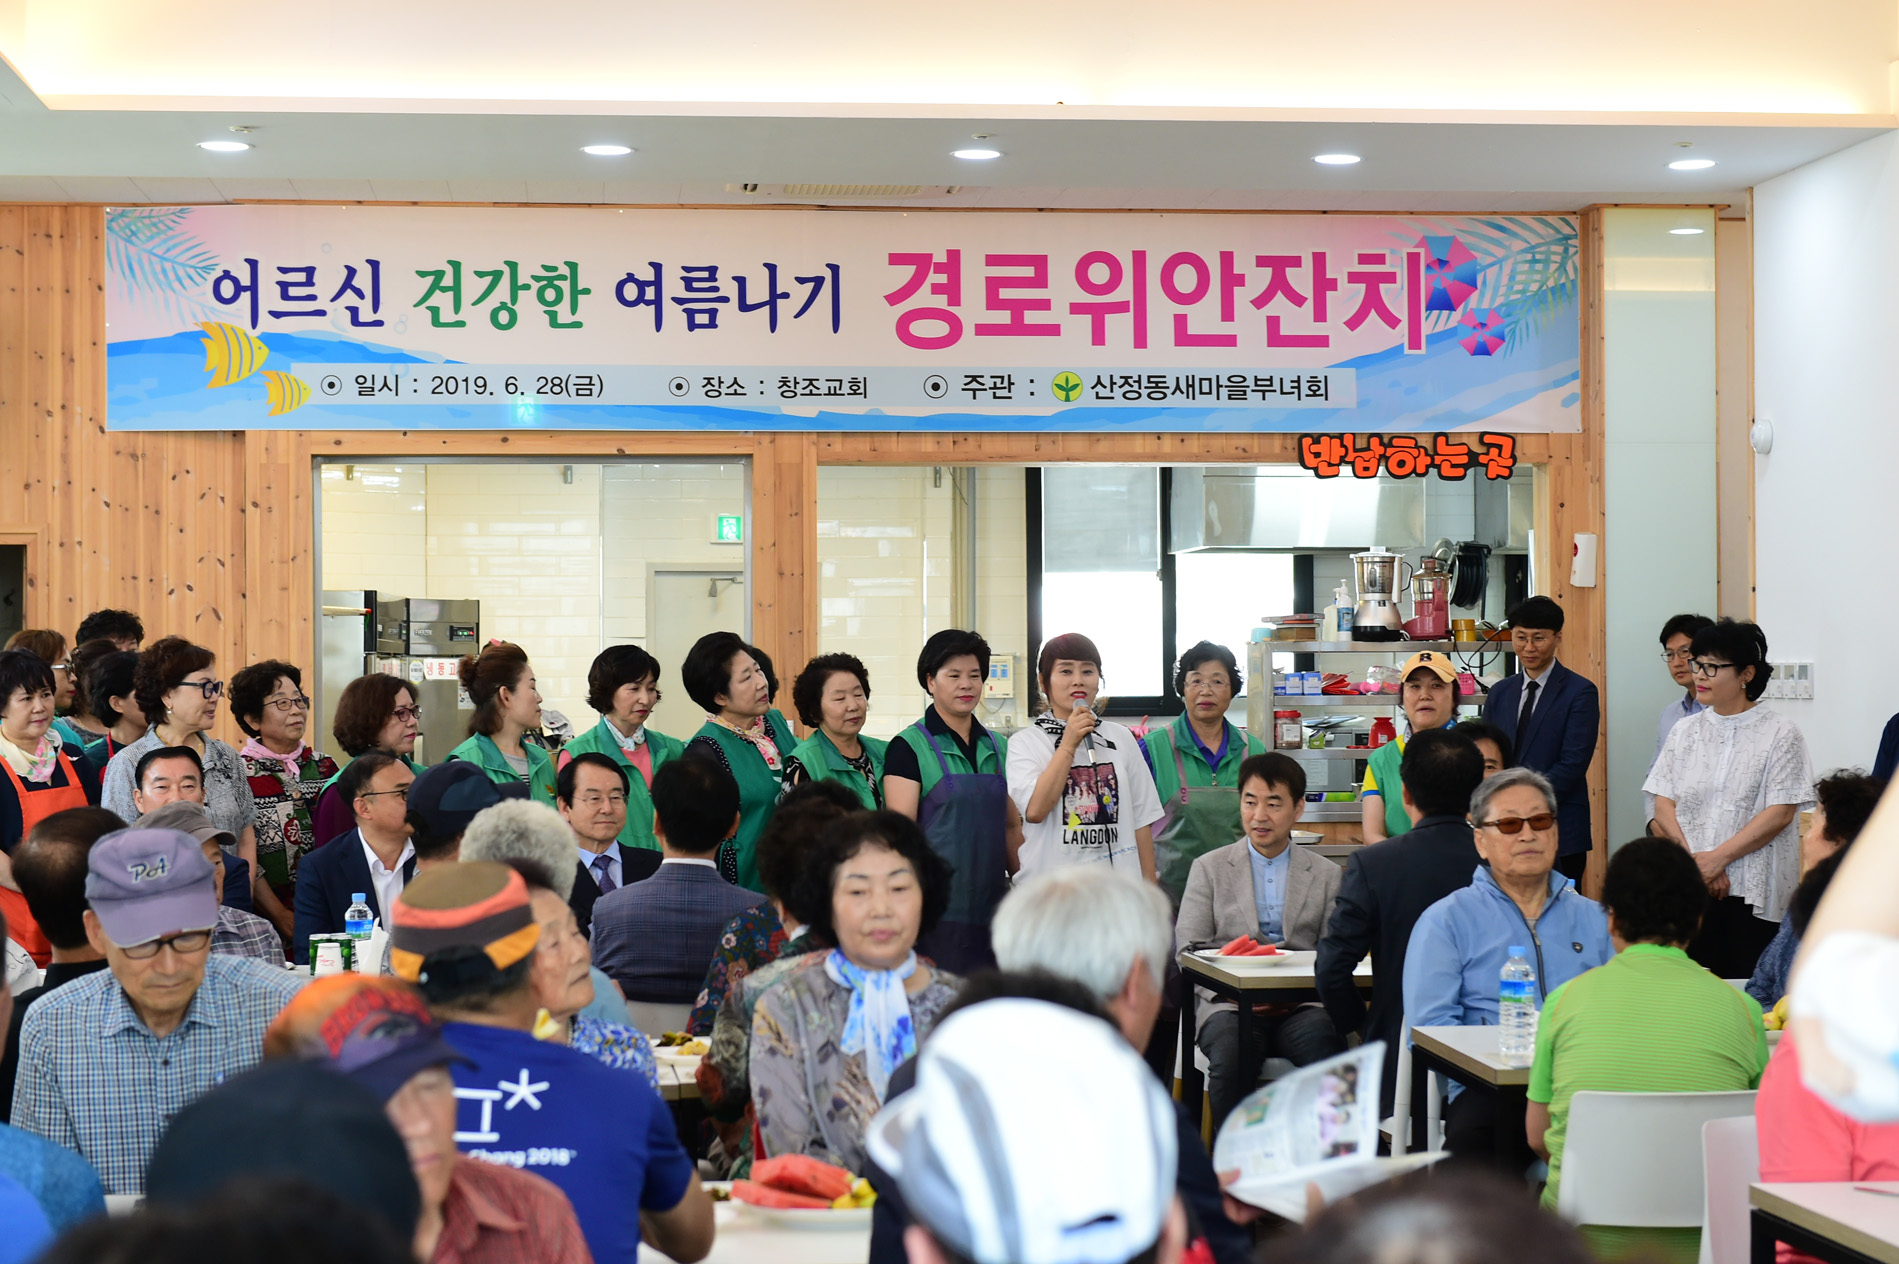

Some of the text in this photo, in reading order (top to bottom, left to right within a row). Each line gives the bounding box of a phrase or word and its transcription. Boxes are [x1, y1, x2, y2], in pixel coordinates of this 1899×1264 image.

[212, 248, 1425, 351] 어르신 건강한 여름나기 경로위안잔치
[355, 374, 400, 397] 일시
[430, 375, 494, 396] 2019.
[504, 375, 526, 396] 6.
[535, 374, 604, 398] 28(금)
[701, 375, 748, 399] 장소
[777, 375, 868, 399] 창조교회
[961, 373, 1016, 401] 주관
[1090, 373, 1330, 402] 산정동새마을부녀회
[426, 662, 457, 676] 냉동고
[1063, 827, 1118, 845] LANGDON
